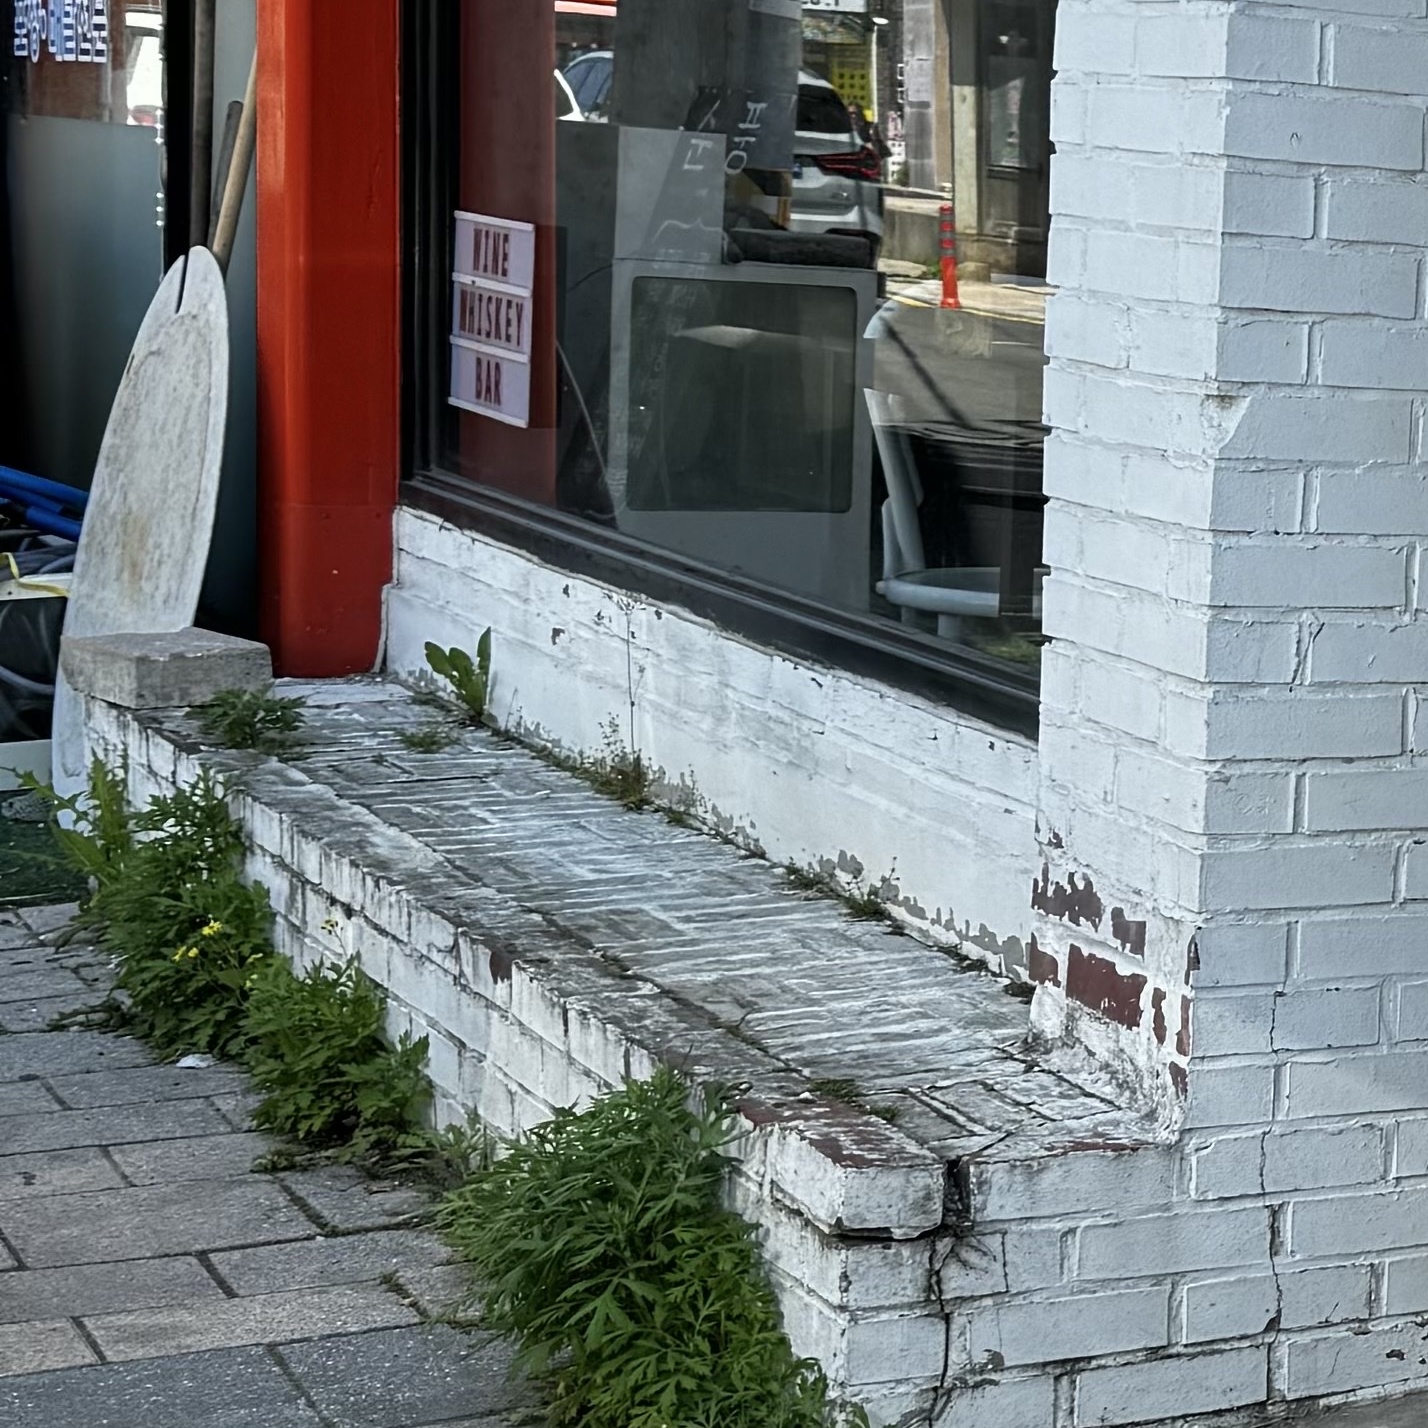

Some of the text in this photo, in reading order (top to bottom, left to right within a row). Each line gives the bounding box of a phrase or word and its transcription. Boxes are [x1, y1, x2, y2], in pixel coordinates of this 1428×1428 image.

[472, 227, 509, 278] WINE
[459, 288, 524, 348] WHISKEY
[474, 356, 503, 407] BAR
